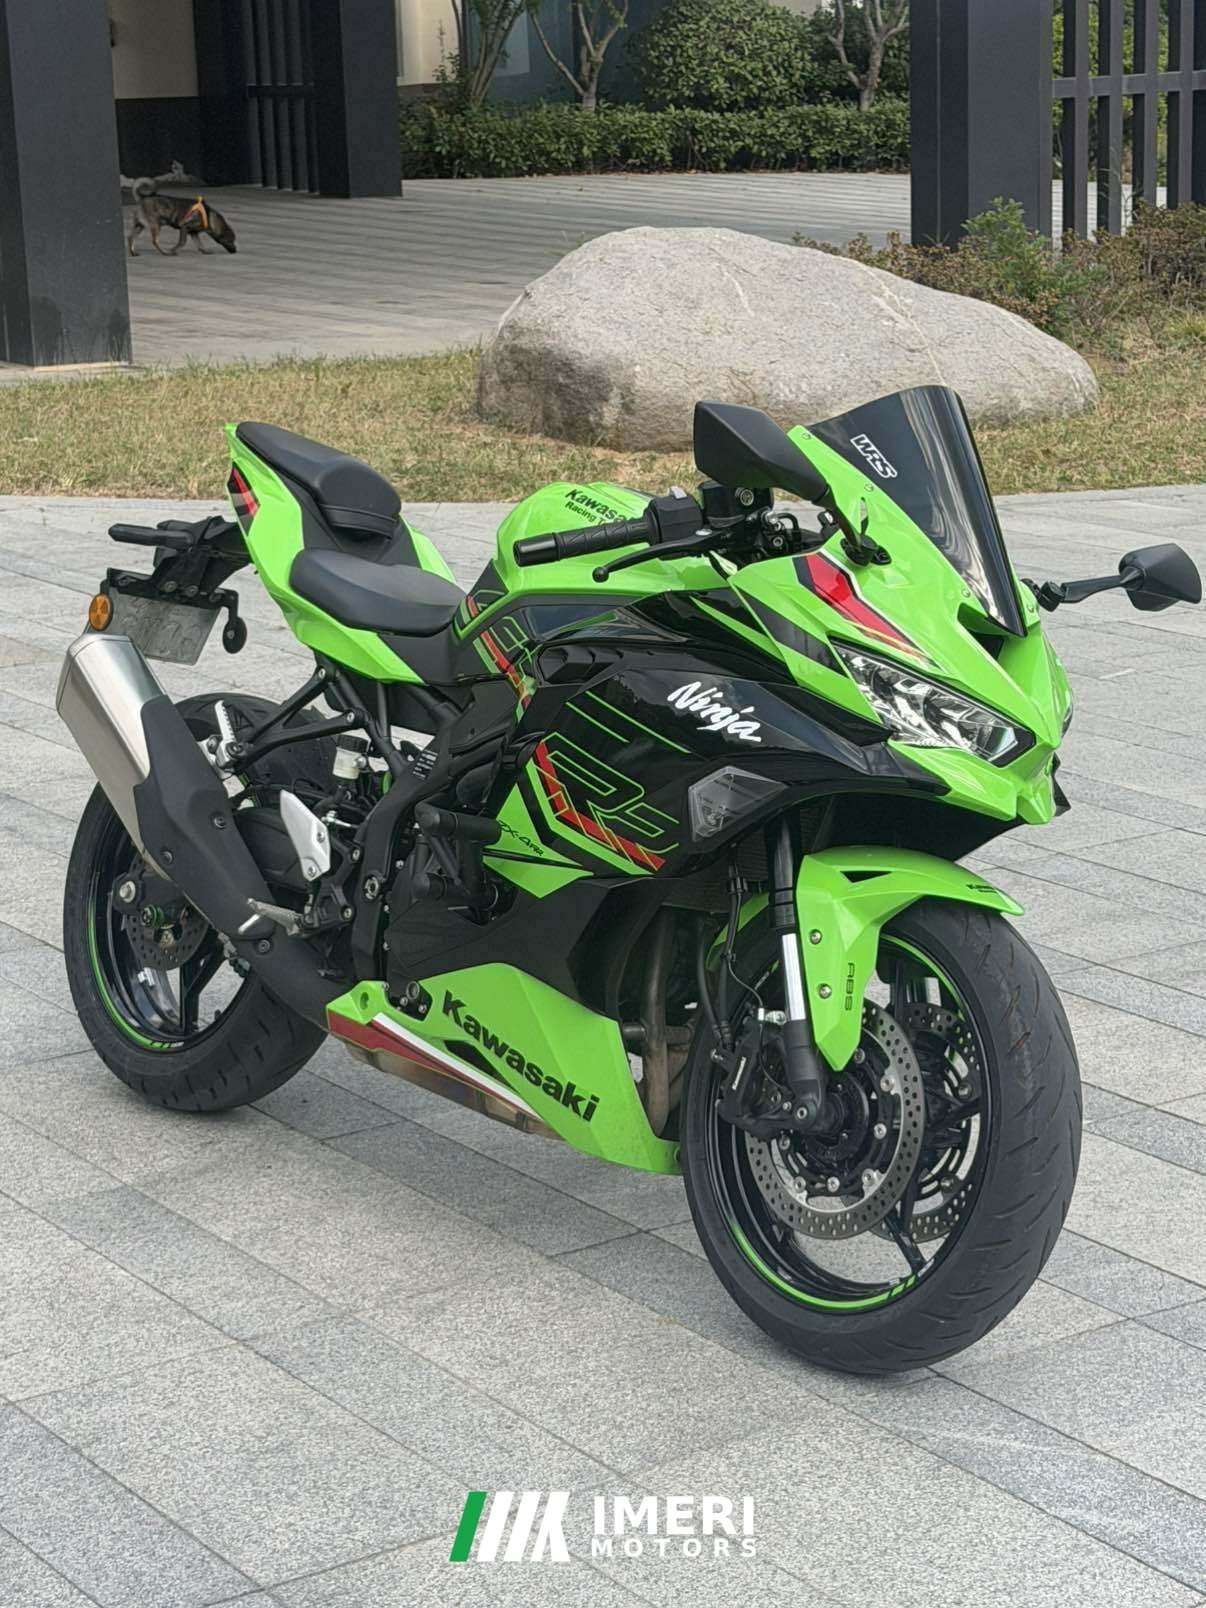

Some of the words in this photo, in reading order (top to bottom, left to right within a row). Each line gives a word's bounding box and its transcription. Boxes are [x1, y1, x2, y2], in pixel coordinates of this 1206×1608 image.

[850, 434, 898, 478] WRS
[565, 489, 634, 523] Kawasa
[565, 501, 597, 522] Racing
[667, 681, 762, 742] Ninja
[845, 962, 855, 1011] ABS
[442, 990, 600, 1122] Kawasaki
